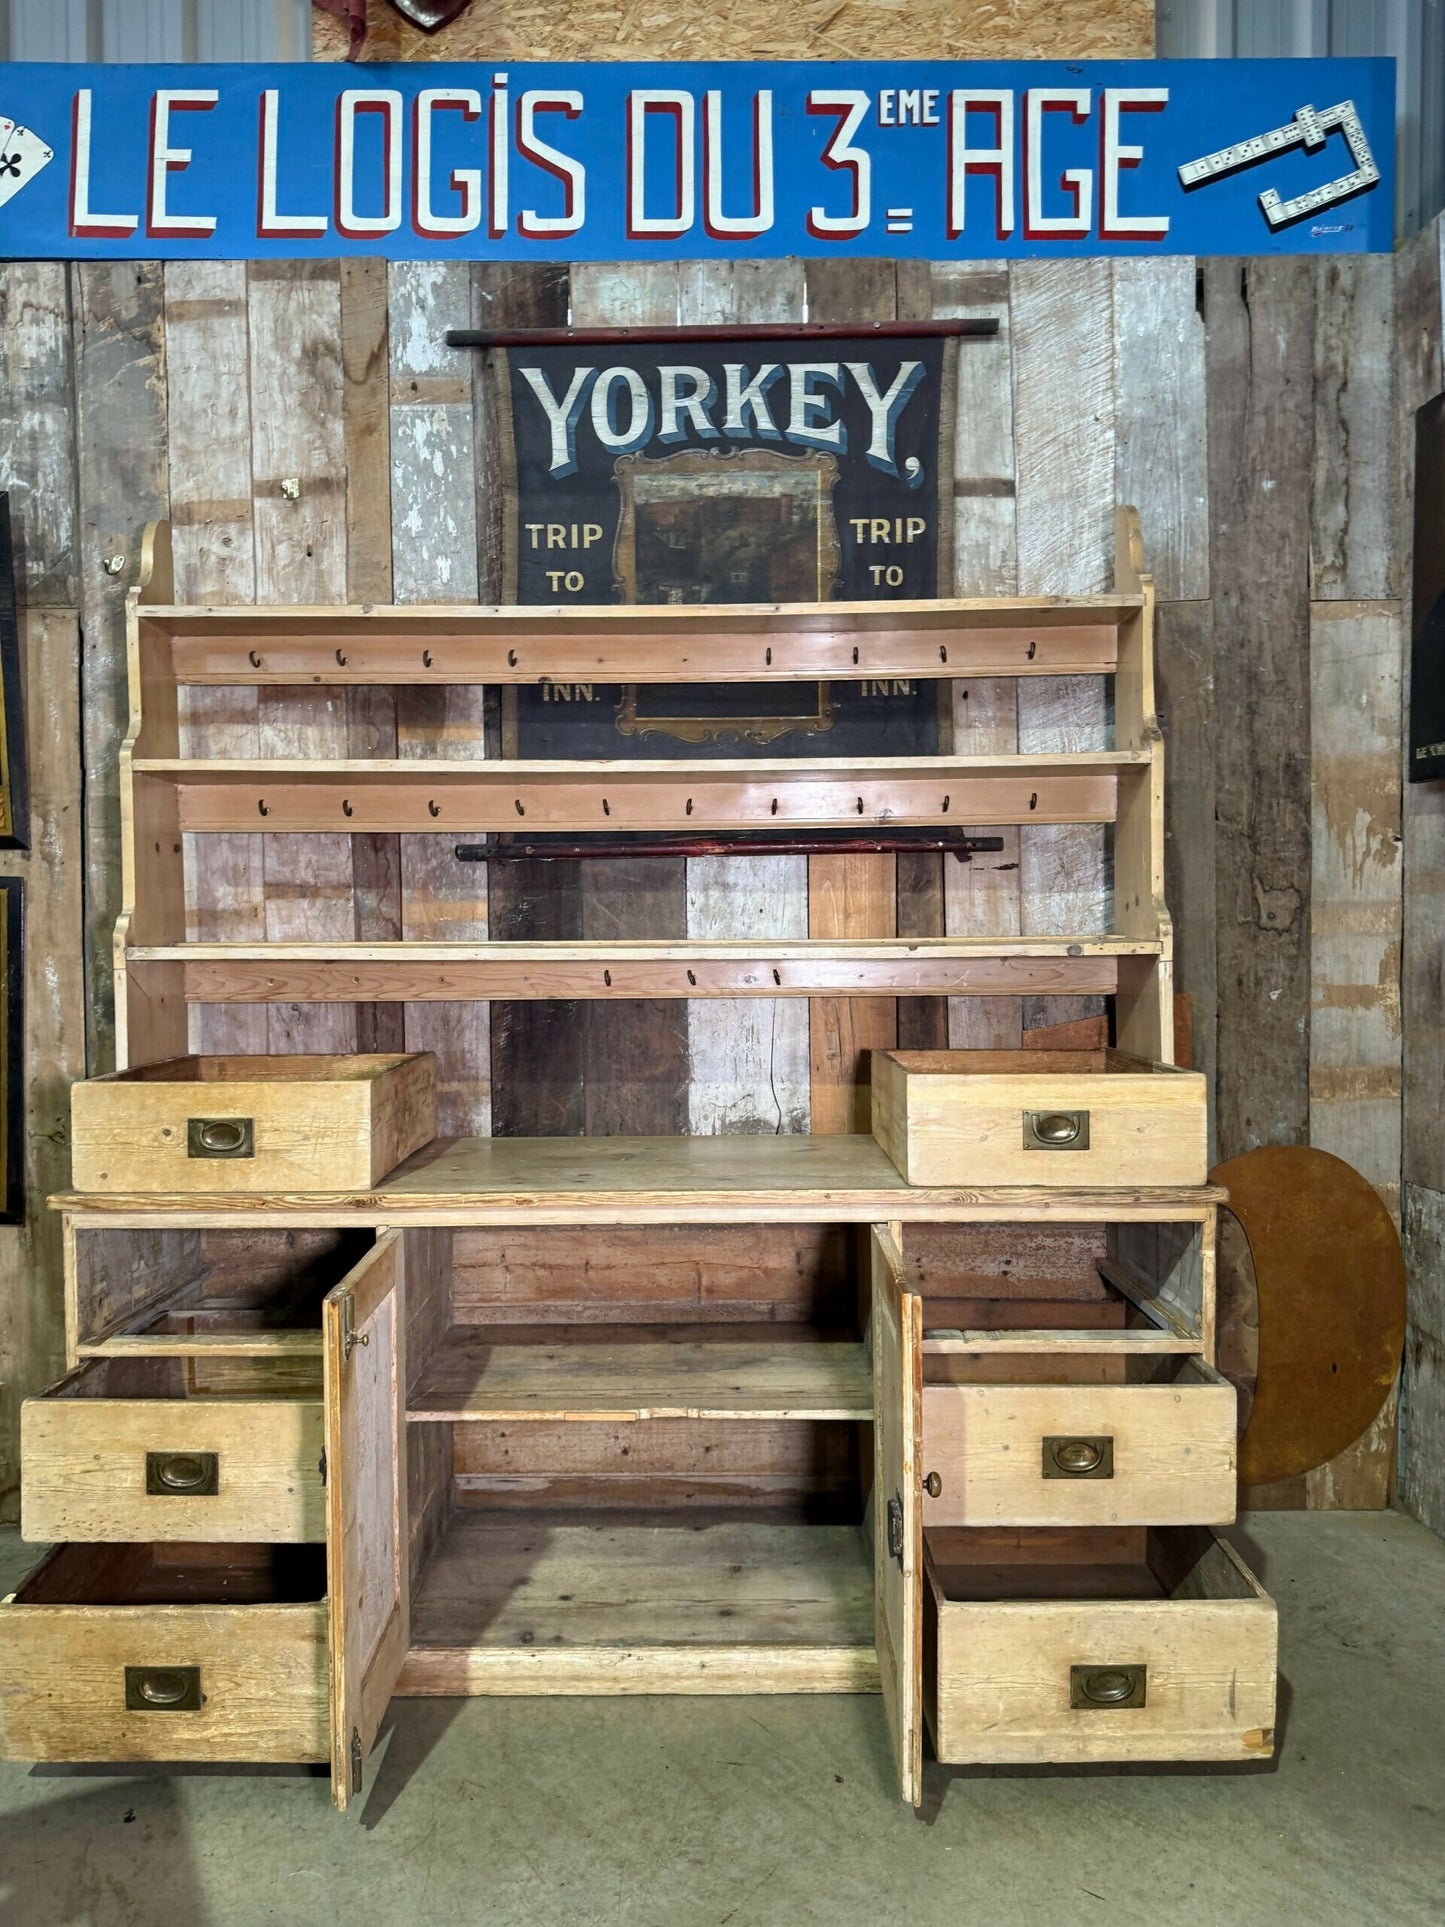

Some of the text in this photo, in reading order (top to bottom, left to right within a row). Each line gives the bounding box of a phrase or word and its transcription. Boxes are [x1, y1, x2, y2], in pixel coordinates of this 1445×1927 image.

[69, 88, 219, 238] LE
[626, 89, 775, 241] DU
[947, 88, 1170, 241] AGE
[519, 360, 926, 489] YORKEY,
[525, 523, 603, 550] TRIP
[849, 517, 926, 545] TRIP
[545, 571, 585, 593] TO
[868, 565, 904, 587] TO
[543, 683, 600, 702] INN.
[861, 679, 918, 697] INN.
